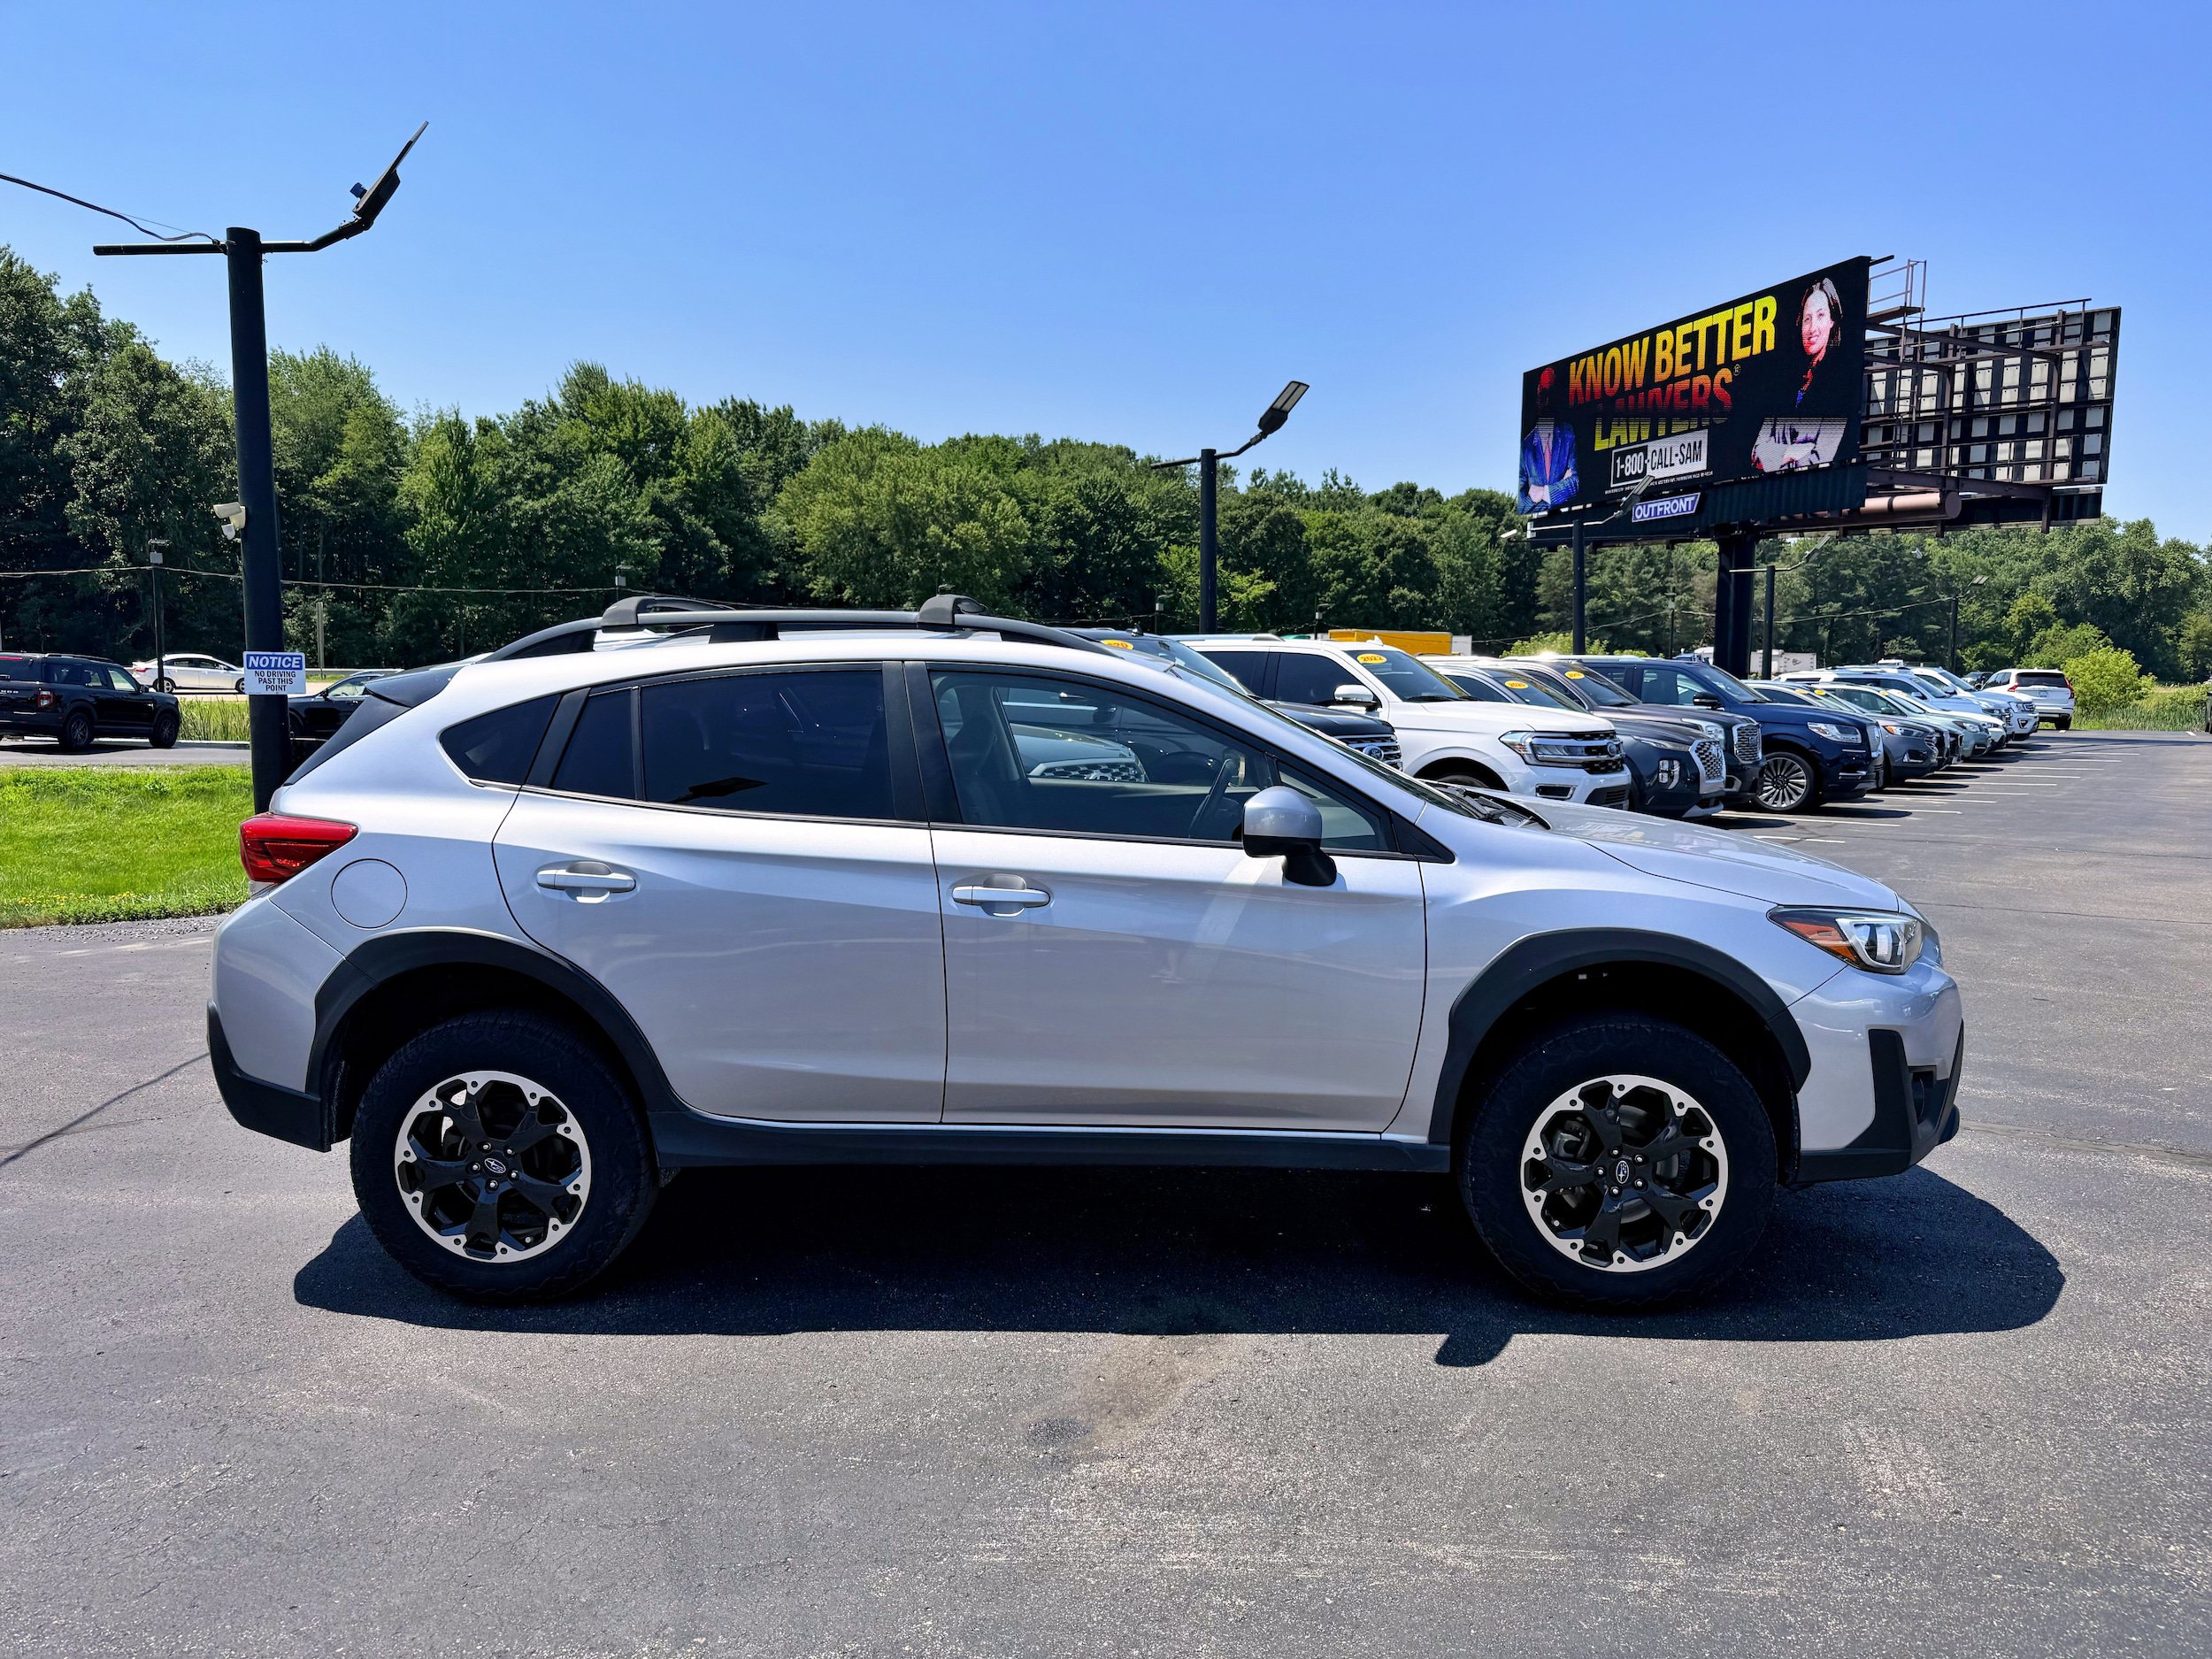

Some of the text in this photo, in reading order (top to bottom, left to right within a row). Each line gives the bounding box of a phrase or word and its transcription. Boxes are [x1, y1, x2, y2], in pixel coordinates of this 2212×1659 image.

[1569, 296, 1778, 407] KNOW BETTER
[1635, 496, 1695, 519] OUTFRONT
[249, 657, 301, 668] NOTICE
